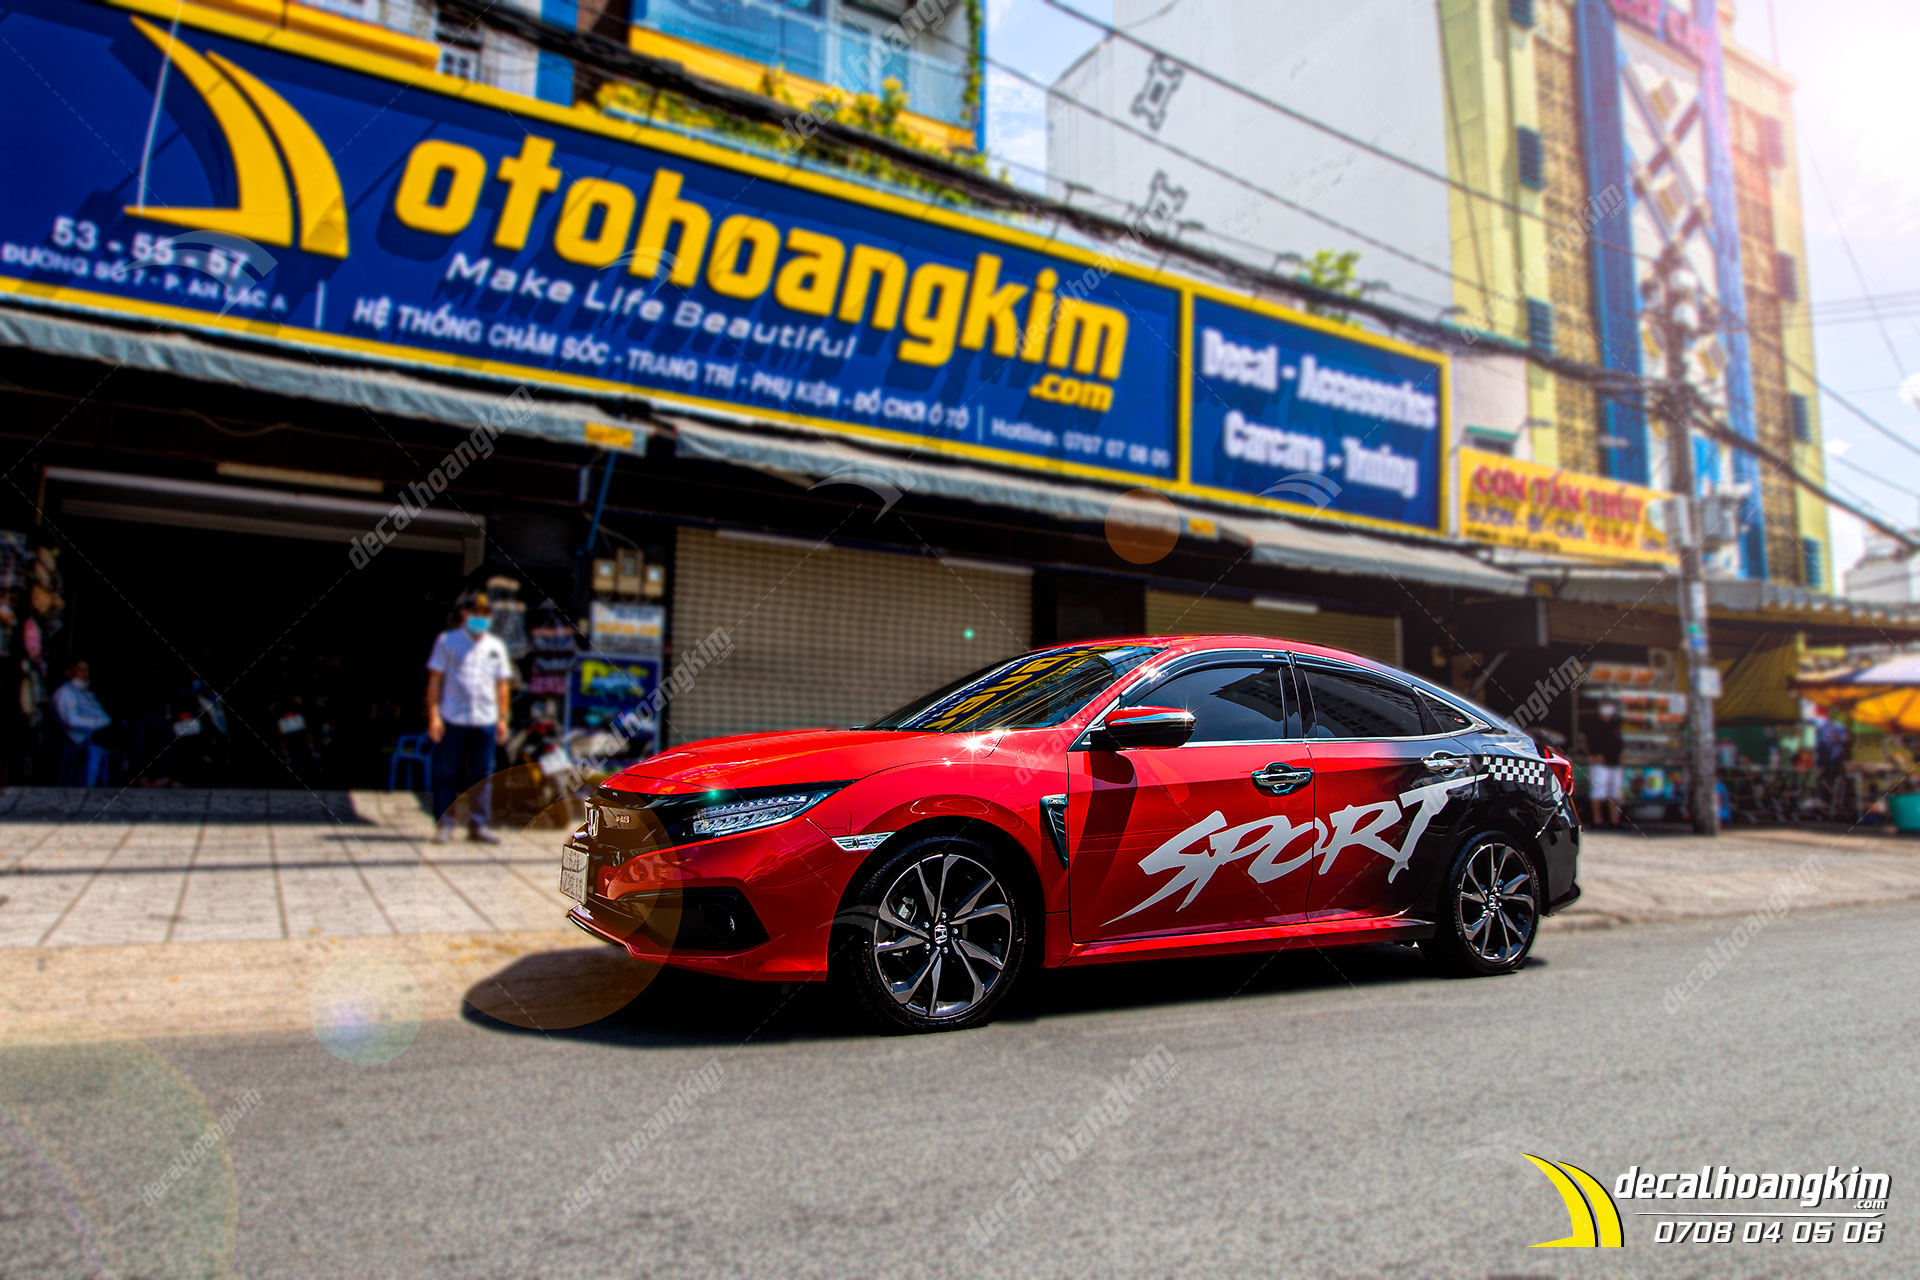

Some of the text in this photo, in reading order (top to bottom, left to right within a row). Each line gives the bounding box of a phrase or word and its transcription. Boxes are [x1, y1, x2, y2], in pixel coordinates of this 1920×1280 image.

[52, 215, 99, 251] 53
[132, 231, 175, 266] 55
[207, 247, 248, 278] 57
[394, 133, 1129, 380] otohoangkim
[352, 295, 391, 331] HỆ
[561, 331, 610, 365] SÓC
[628, 347, 698, 382] TRANG
[445, 251, 857, 359] Make Life Beautiful
[1029, 373, 1115, 413] .com
[1202, 327, 1279, 393] Decal
[1100, 774, 1488, 927] SPORT
